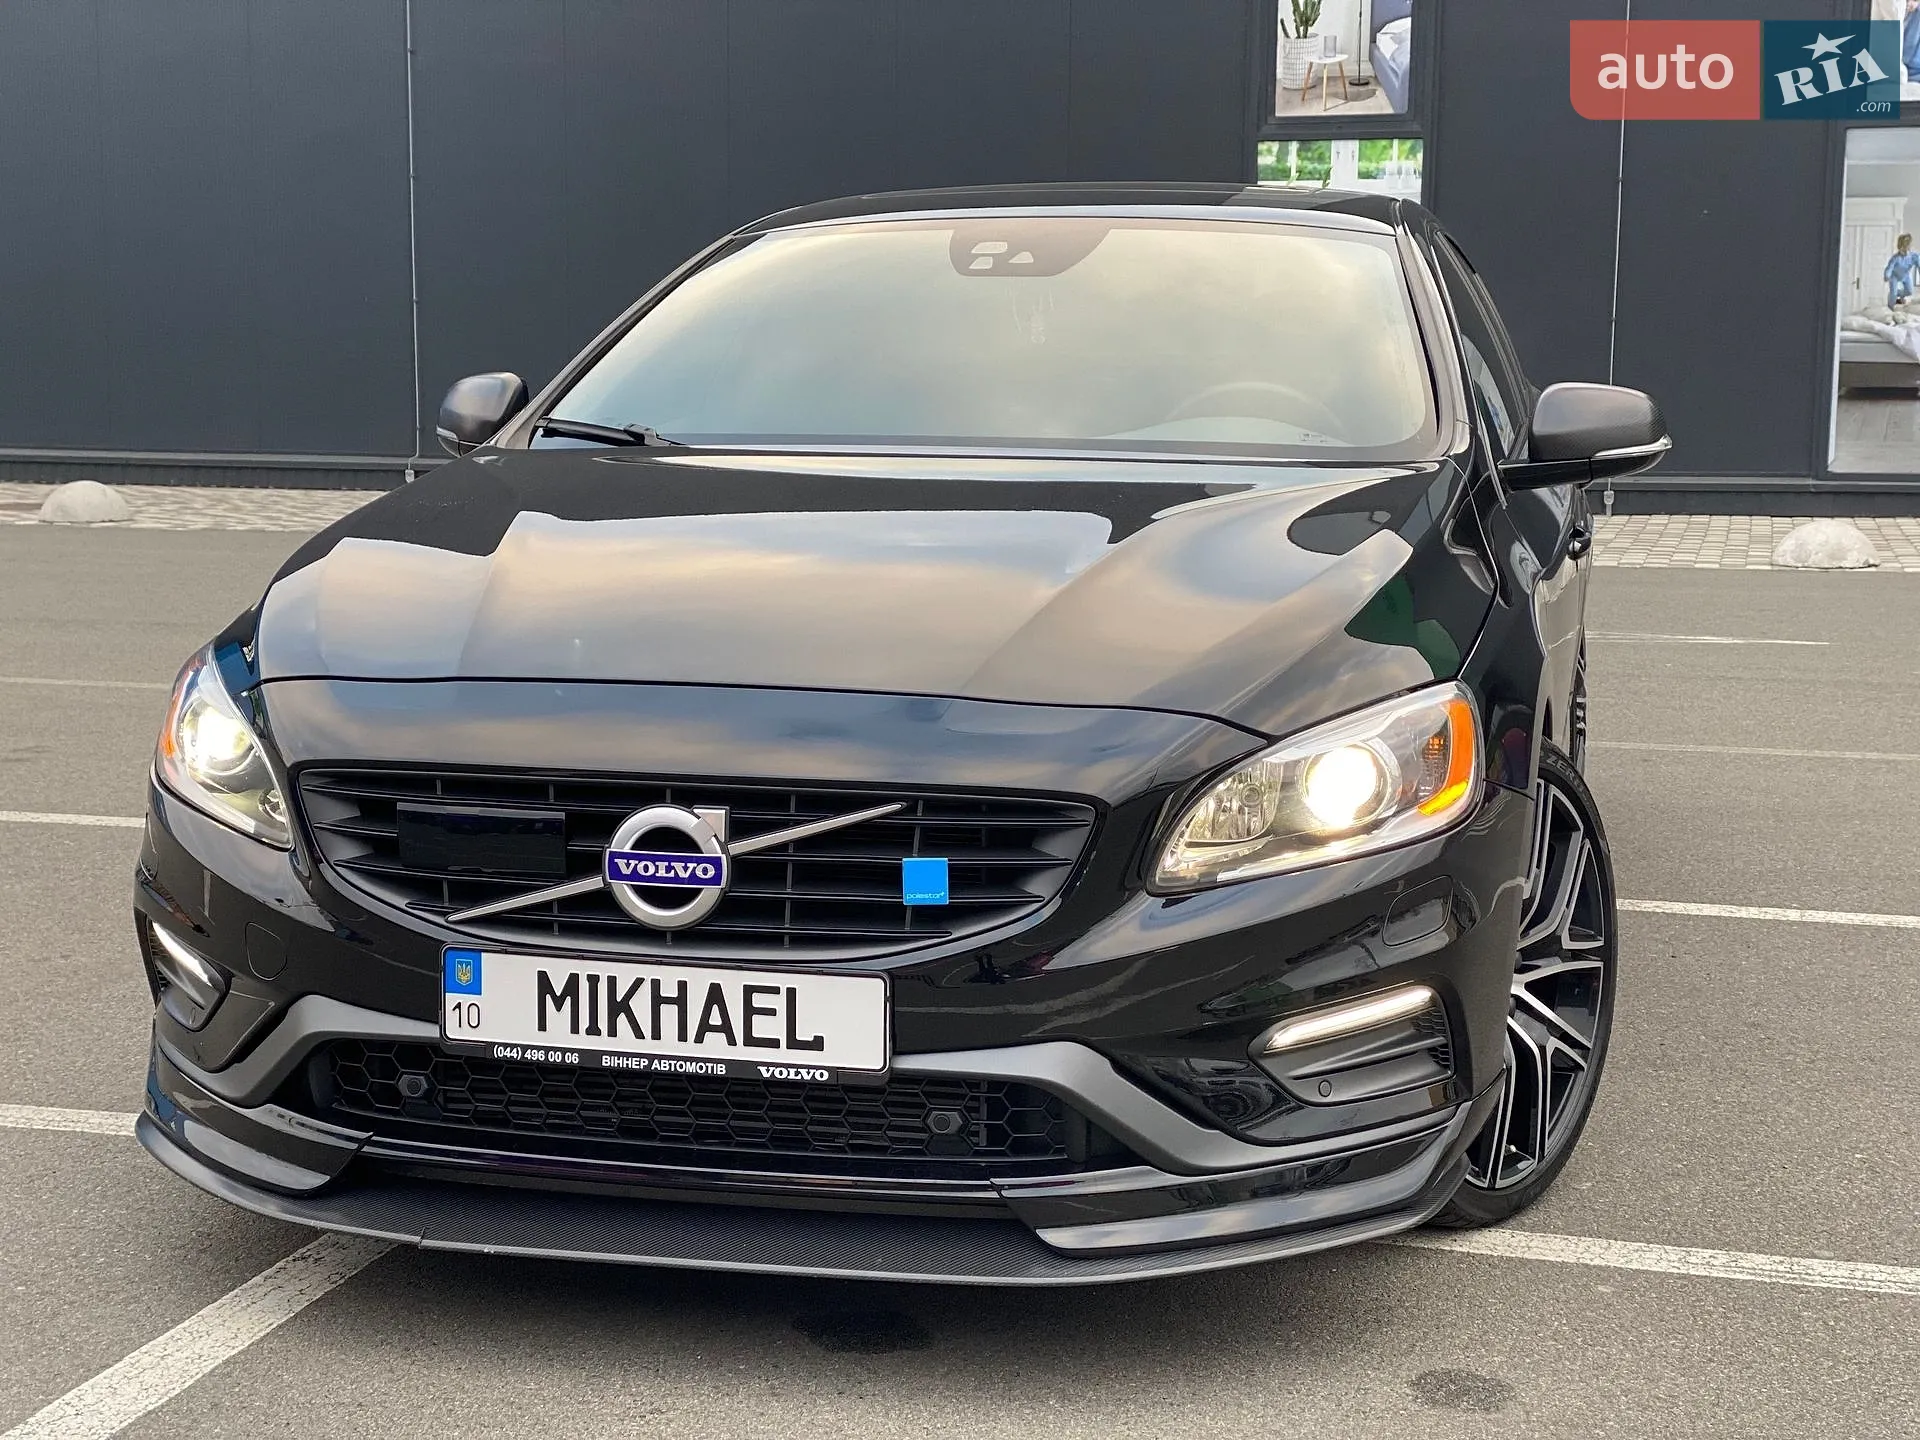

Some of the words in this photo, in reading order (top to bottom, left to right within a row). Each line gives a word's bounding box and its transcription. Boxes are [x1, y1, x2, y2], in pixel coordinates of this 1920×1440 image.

[614, 858, 716, 879] VOLVO
[452, 1001, 481, 1029] 10
[537, 970, 824, 1051] MIKHAEL
[493, 1044, 522, 1060] (044)
[524, 1046, 546, 1062] 496
[548, 1050, 562, 1063] 00
[564, 1051, 579, 1064] 06
[601, 1055, 649, 1072] ВІННЕР
[650, 1058, 727, 1075] АВТОМОТІВ
[757, 1065, 829, 1081] VOLVO
